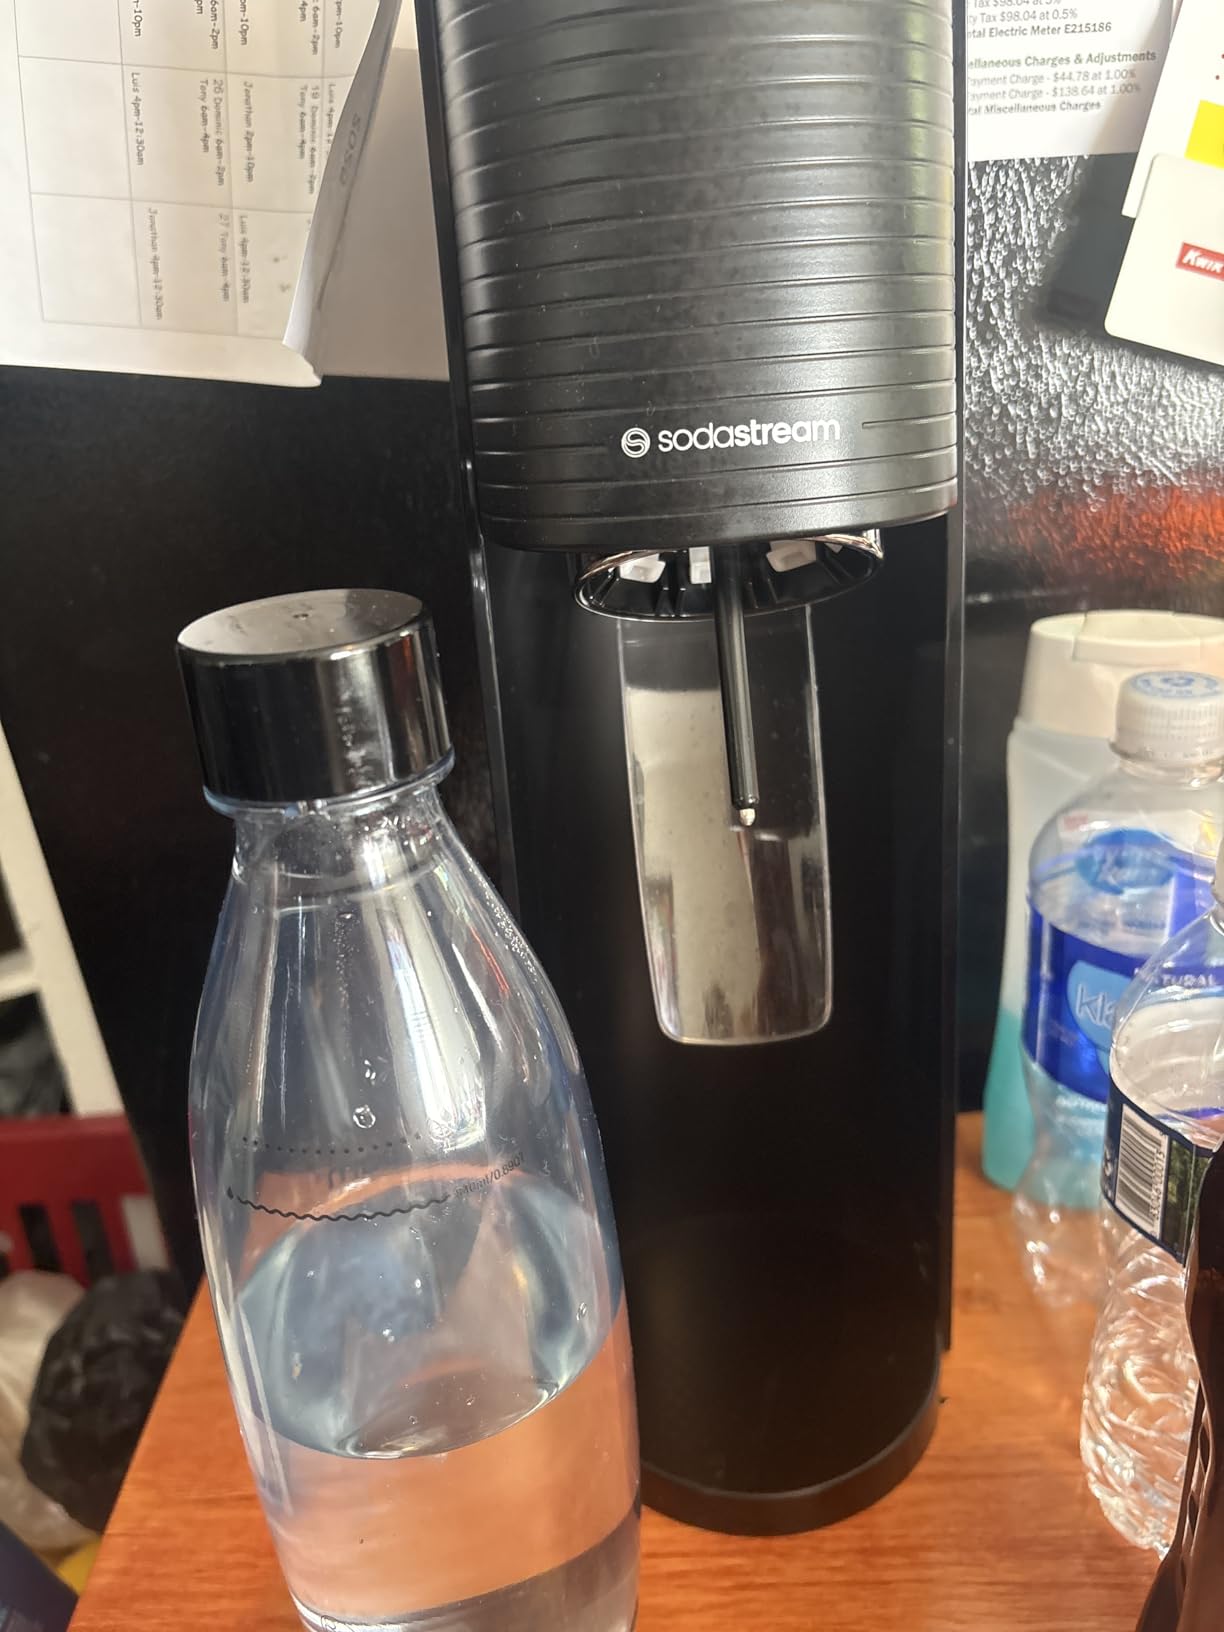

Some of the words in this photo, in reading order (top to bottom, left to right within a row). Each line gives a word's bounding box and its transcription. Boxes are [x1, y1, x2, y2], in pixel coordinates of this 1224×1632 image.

[980, 13, 997, 22] Tax
[1000, 10, 1037, 22] $98.04
[1039, 10, 1050, 20] at
[1052, 8, 1078, 20] 0.5%
[988, 25, 1028, 38] Electric
[1030, 24, 1061, 36] Meter
[1064, 22, 1112, 34] E215186
[1025, 54, 1071, 68] Charges
[1074, 54, 1083, 64] &
[1086, 50, 1157, 66] Adjustments
[131, 72, 141, 94] Luis
[1009, 72, 1045, 86] Charge
[1091, 70, 1102, 81] at
[1105, 68, 1137, 81] 1.00%
[199, 79, 209, 102] Tony
[213, 79, 224, 95] 26
[1008, 87, 1043, 101] Charge
[1097, 84, 1108, 96] at
[1059, 99, 1102, 112] Charges
[131, 95, 145, 166] 4pm-12:30am
[200, 105, 210, 153] 6am-4pm
[215, 138, 226, 187] 6am-2pm
[658, 419, 841, 452] sodastream
